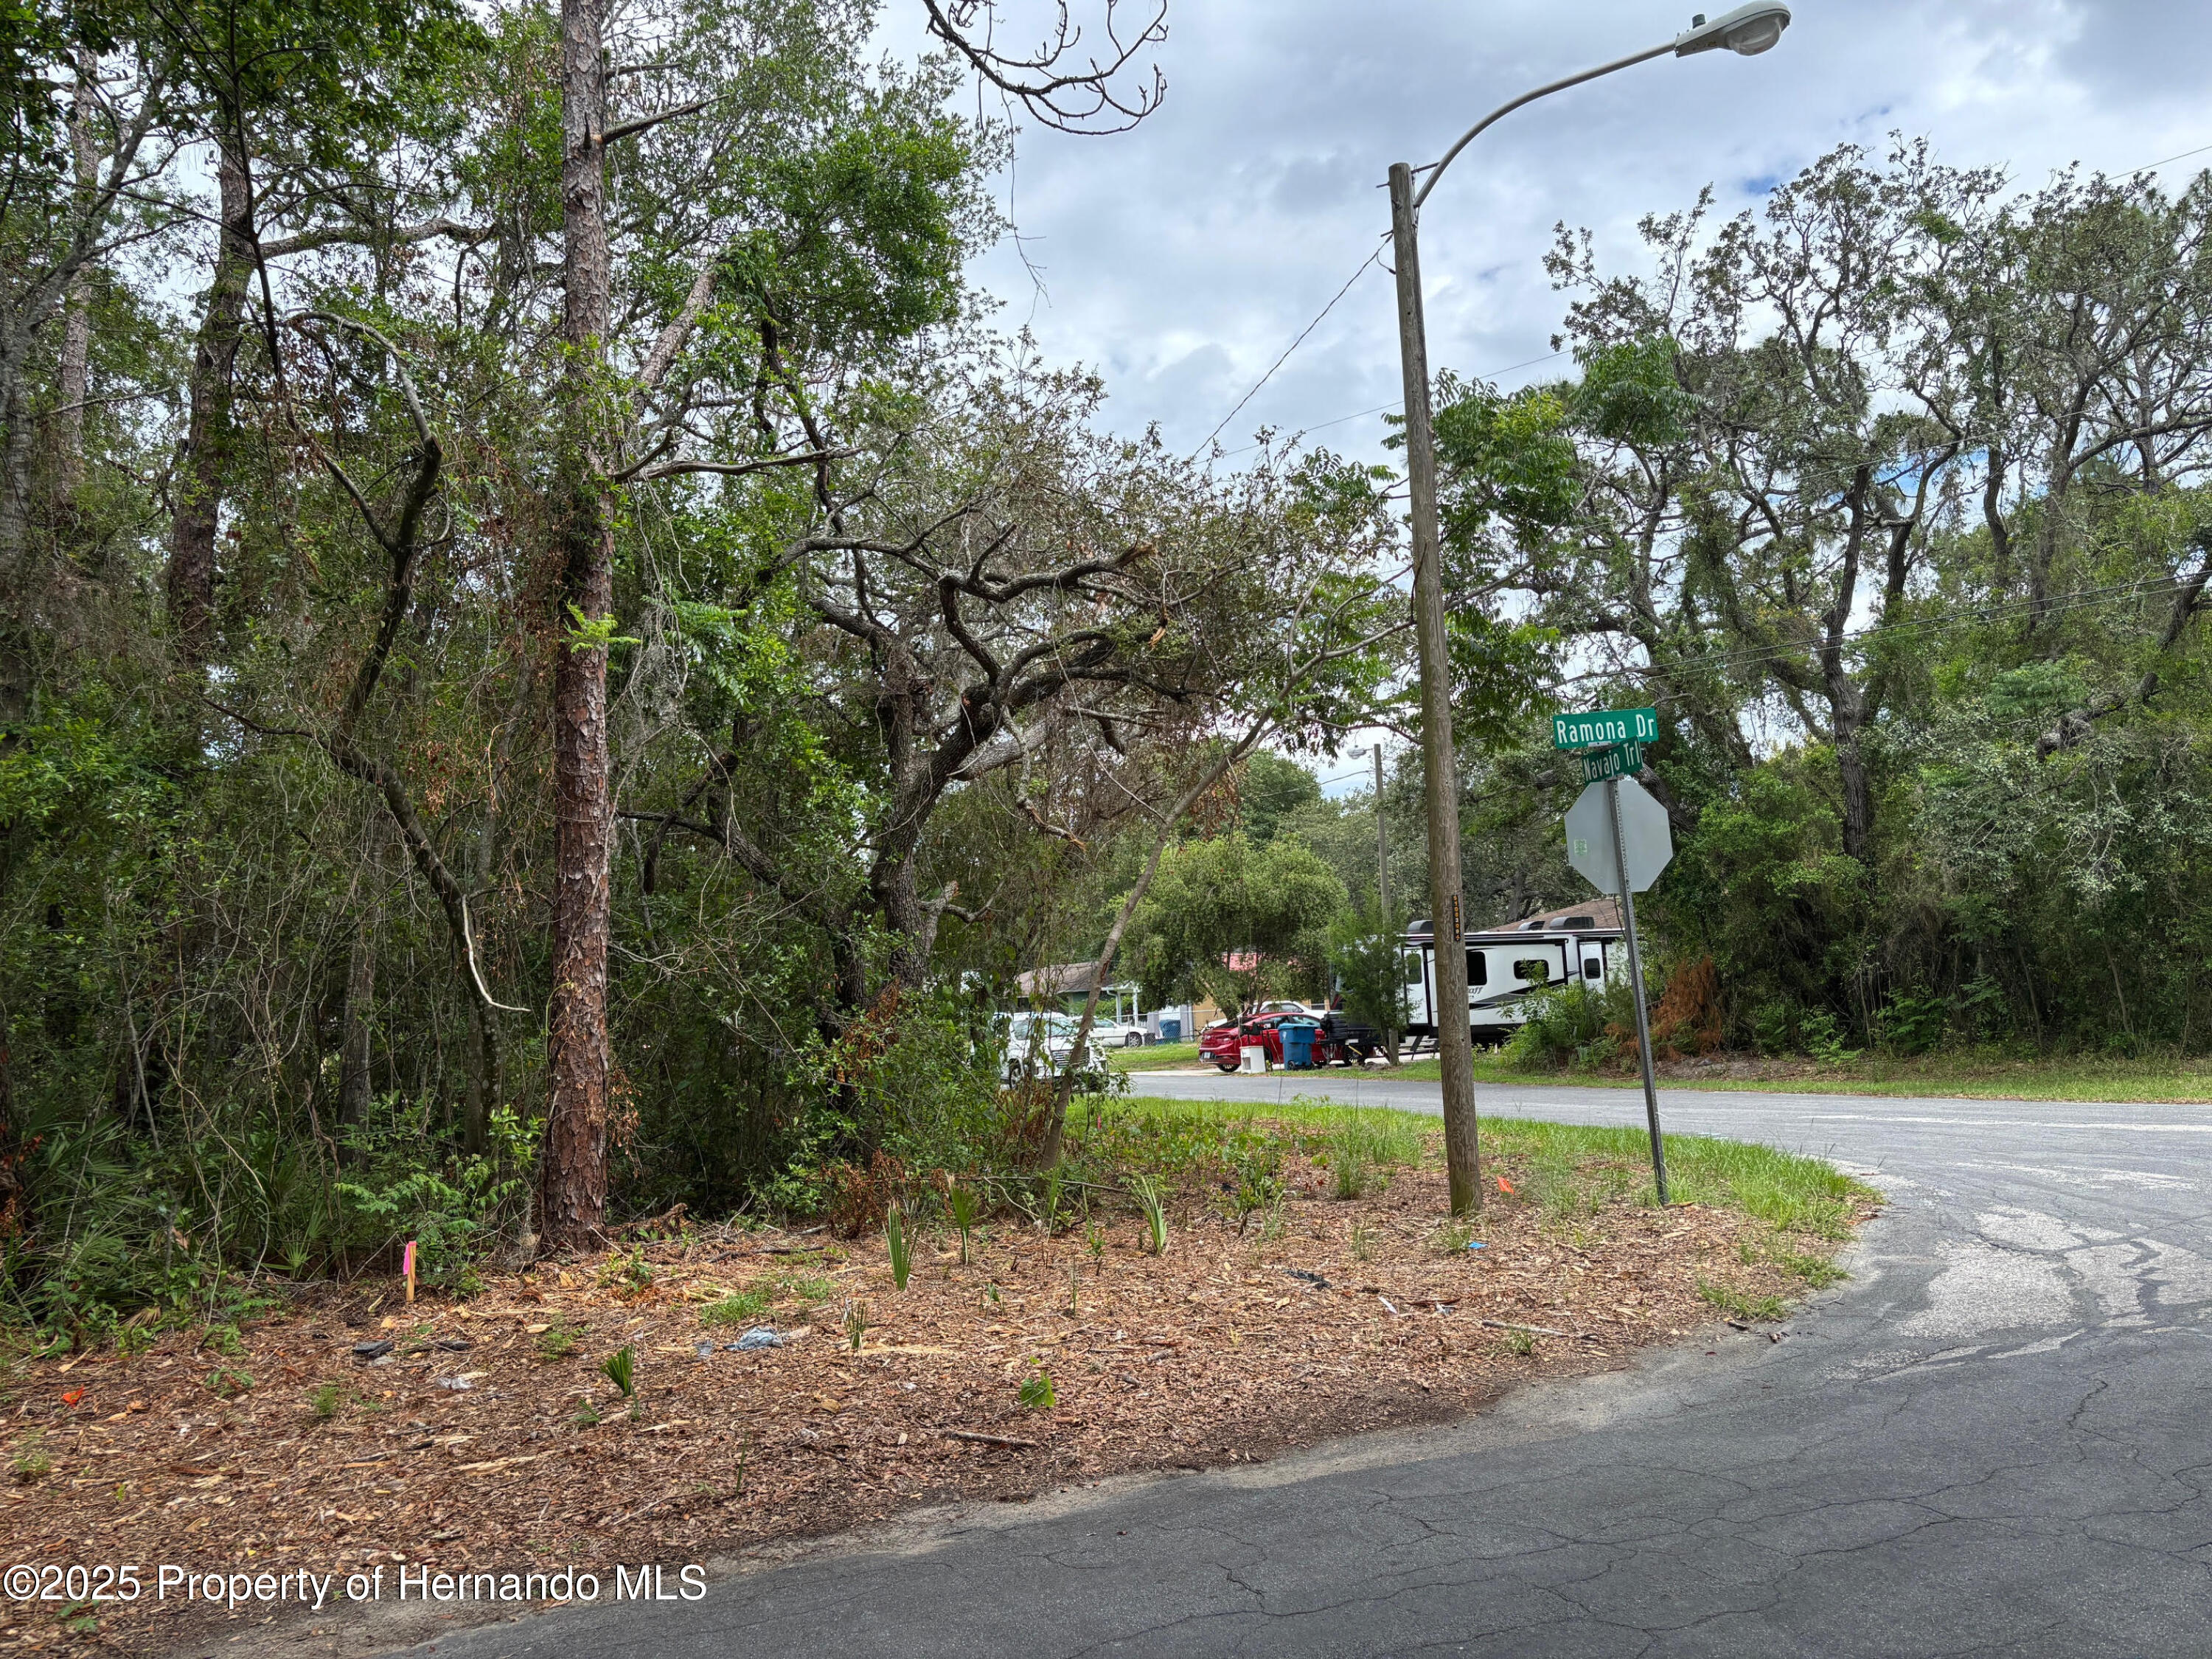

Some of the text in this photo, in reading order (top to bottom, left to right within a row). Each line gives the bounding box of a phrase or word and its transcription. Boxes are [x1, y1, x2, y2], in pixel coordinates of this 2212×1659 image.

[1557, 714, 1655, 744] Ramona Dr
[1583, 740, 1641, 782] Navajo Trl
